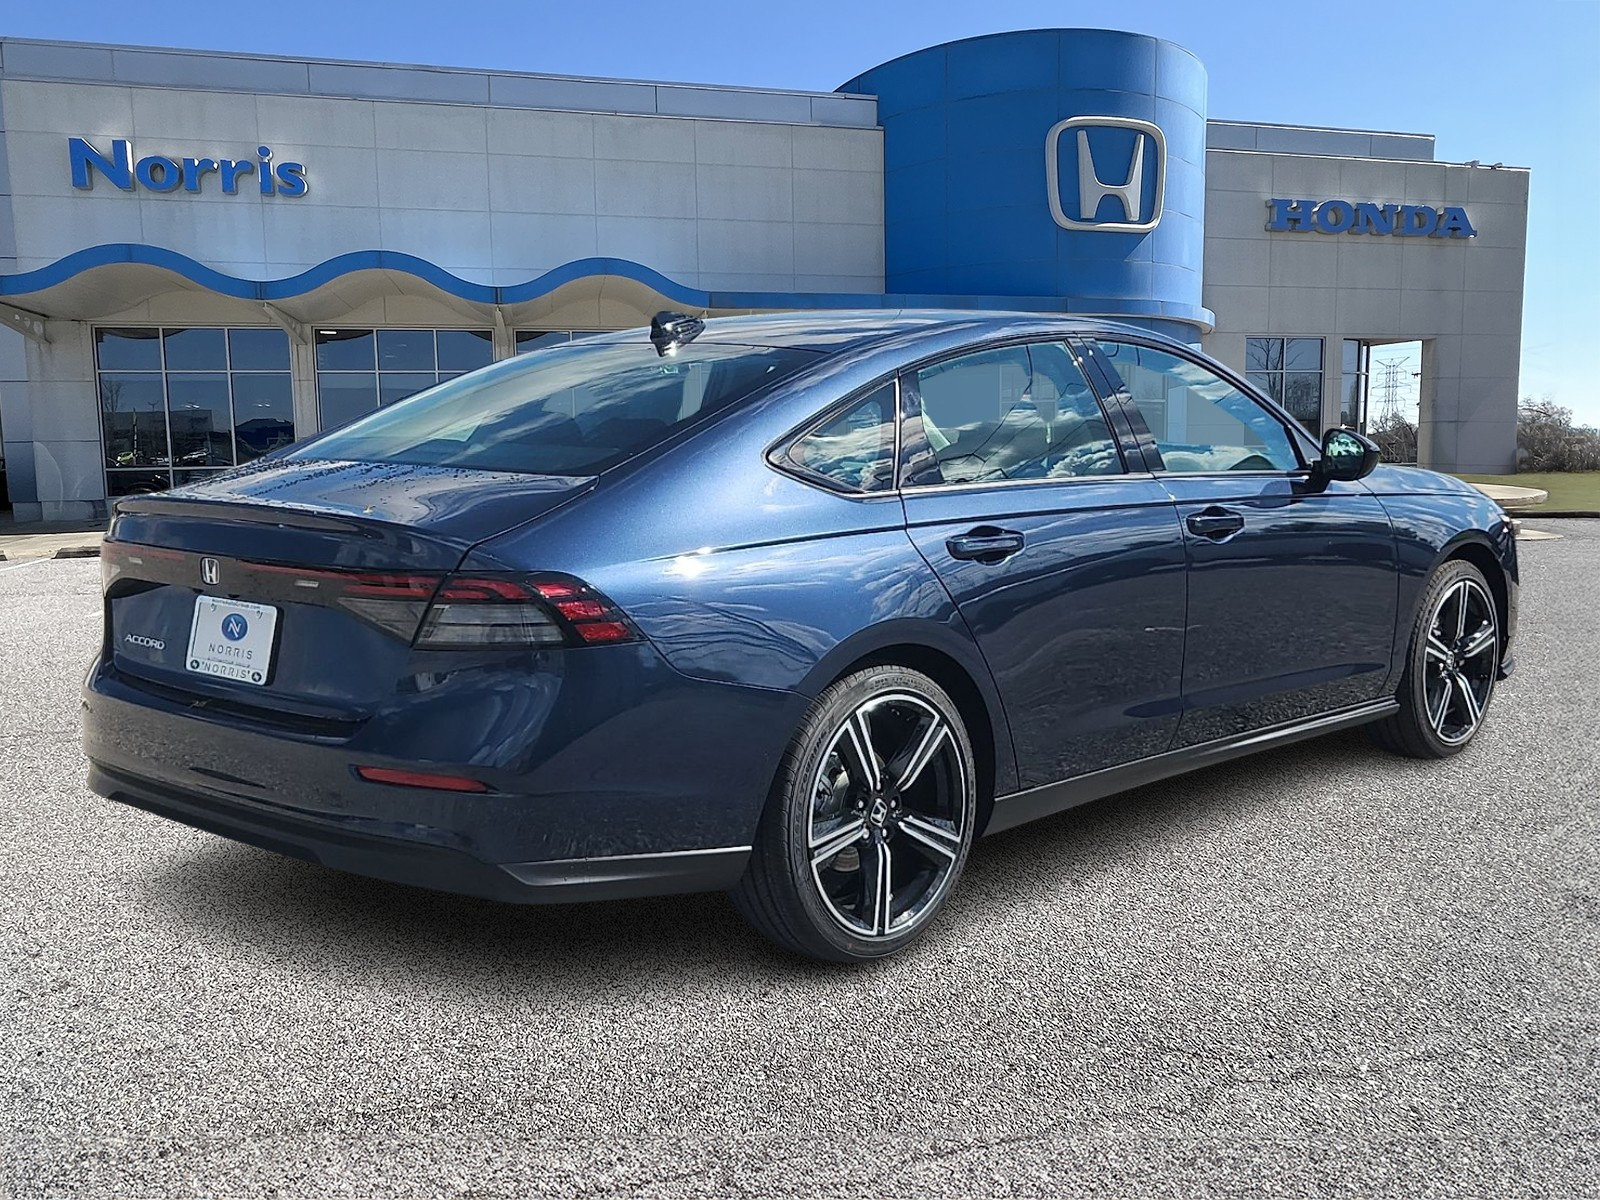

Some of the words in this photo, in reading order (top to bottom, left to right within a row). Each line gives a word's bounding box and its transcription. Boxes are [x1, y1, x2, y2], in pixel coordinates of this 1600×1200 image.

[68, 137, 309, 198] Norris
[1265, 198, 1478, 239] HONDA
[124, 634, 165, 650] ACCORD
[208, 642, 253, 660] NORRIS
